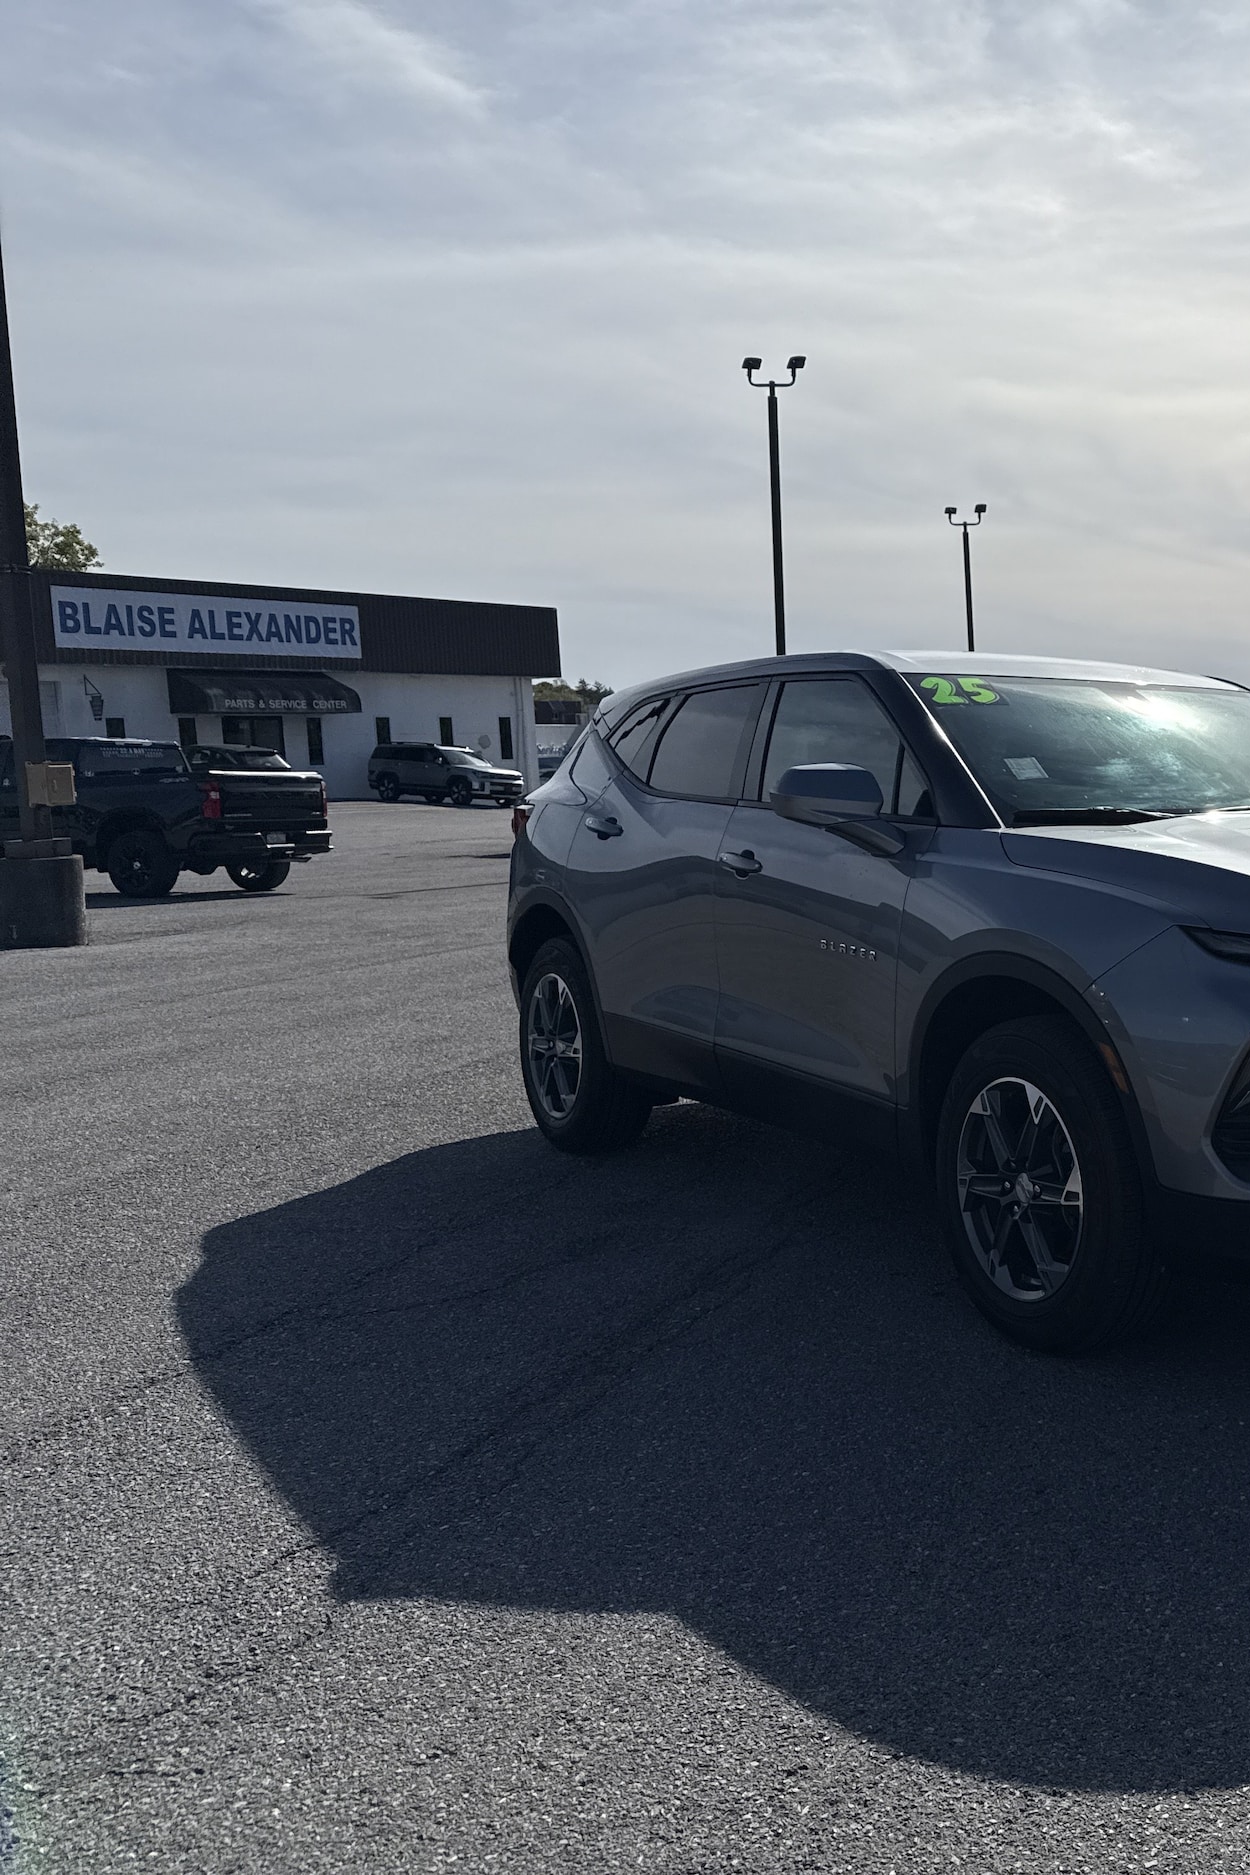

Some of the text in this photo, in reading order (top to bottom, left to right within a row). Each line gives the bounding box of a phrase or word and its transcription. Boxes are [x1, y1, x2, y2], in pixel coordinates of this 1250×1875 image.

[57, 600, 358, 646] BLAISE ALEXANDER
[919, 675, 1001, 705] 25
[224, 698, 347, 710] PARTS & SERVICE CENTER
[819, 938, 878, 962] BLAZER
